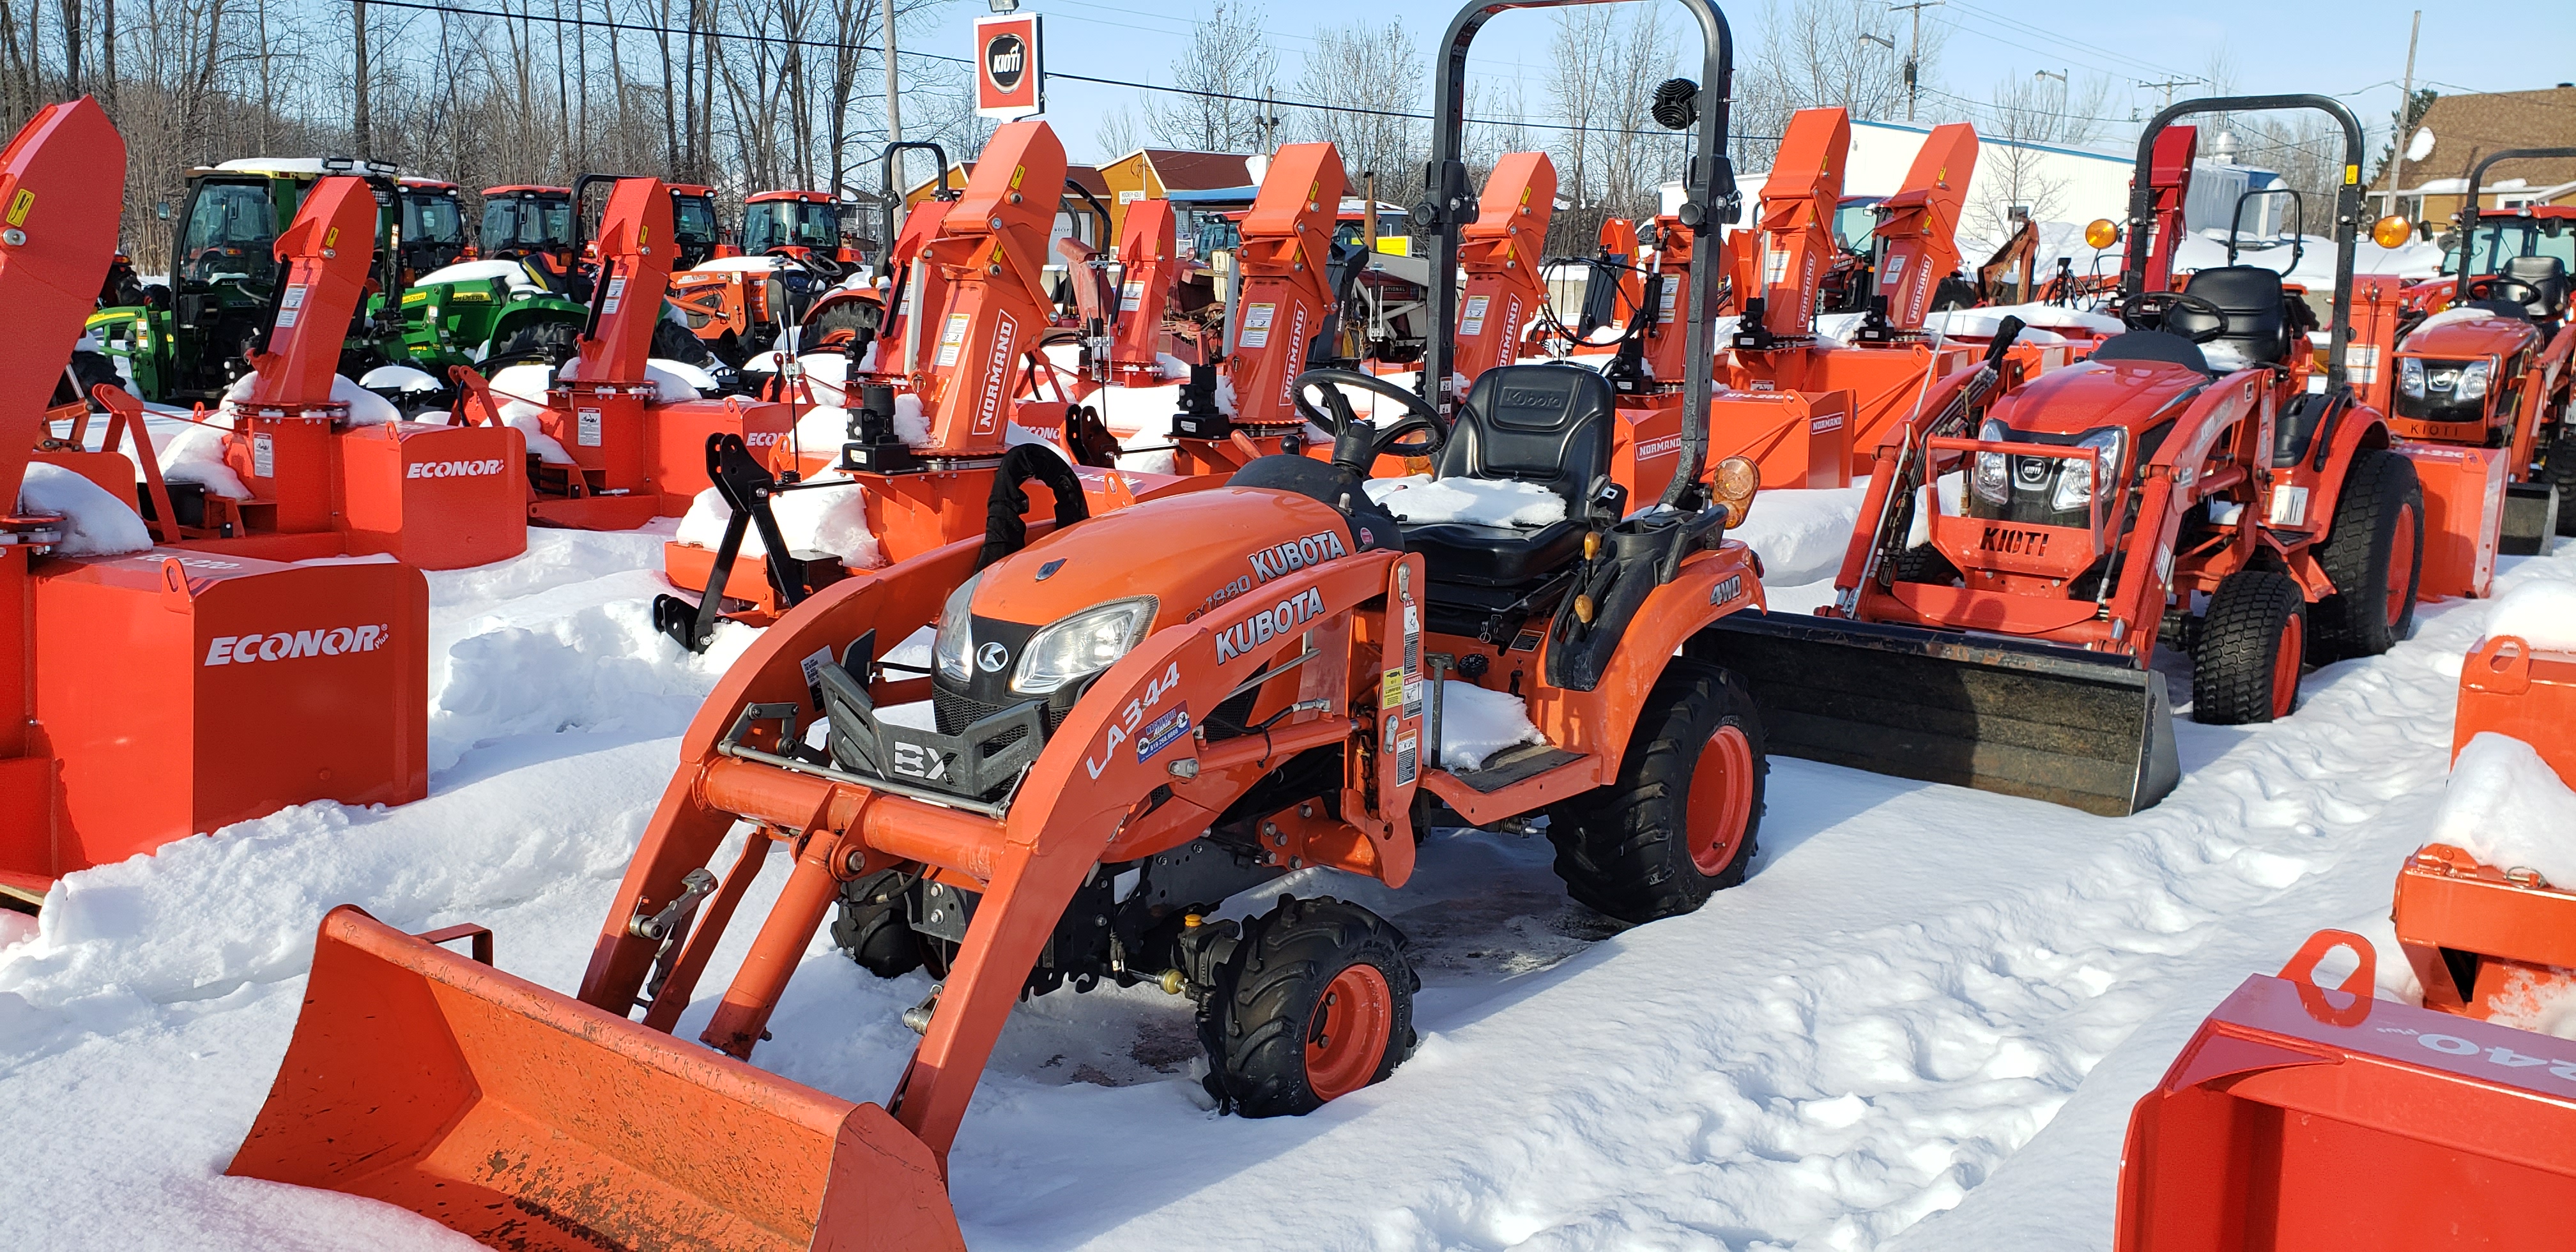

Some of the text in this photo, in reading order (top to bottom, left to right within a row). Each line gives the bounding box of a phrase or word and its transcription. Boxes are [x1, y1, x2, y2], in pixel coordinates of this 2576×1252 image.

[993, 53, 1021, 73] KIOTI
[1800, 258, 1814, 323] NORMAND
[1910, 260, 1930, 319] NORMAND
[1499, 302, 1519, 367] ORMAND
[1284, 310, 1304, 399] NORMAND
[980, 321, 1013, 427] NORMAND
[1506, 390, 1561, 408] Kubota
[1813, 416, 1842, 431] NORMAND
[2411, 424, 2458, 436] KIOTI
[1639, 438, 1681, 456] NORMAND
[406, 459, 500, 479] ECONOR
[2023, 466, 2042, 474] KIOTI
[1248, 530, 1347, 583] KUBOTA
[1980, 527, 2050, 556] KIOTI
[1710, 574, 1742, 606] 4WD
[1215, 586, 1326, 666] KUBOTA
[204, 624, 389, 666] ECONOR Plus
[1086, 660, 1180, 779] LA344
[1146, 708, 1177, 736] MACHINERIE
[1149, 742, 1159, 751] 819
[894, 741, 958, 786] BX
